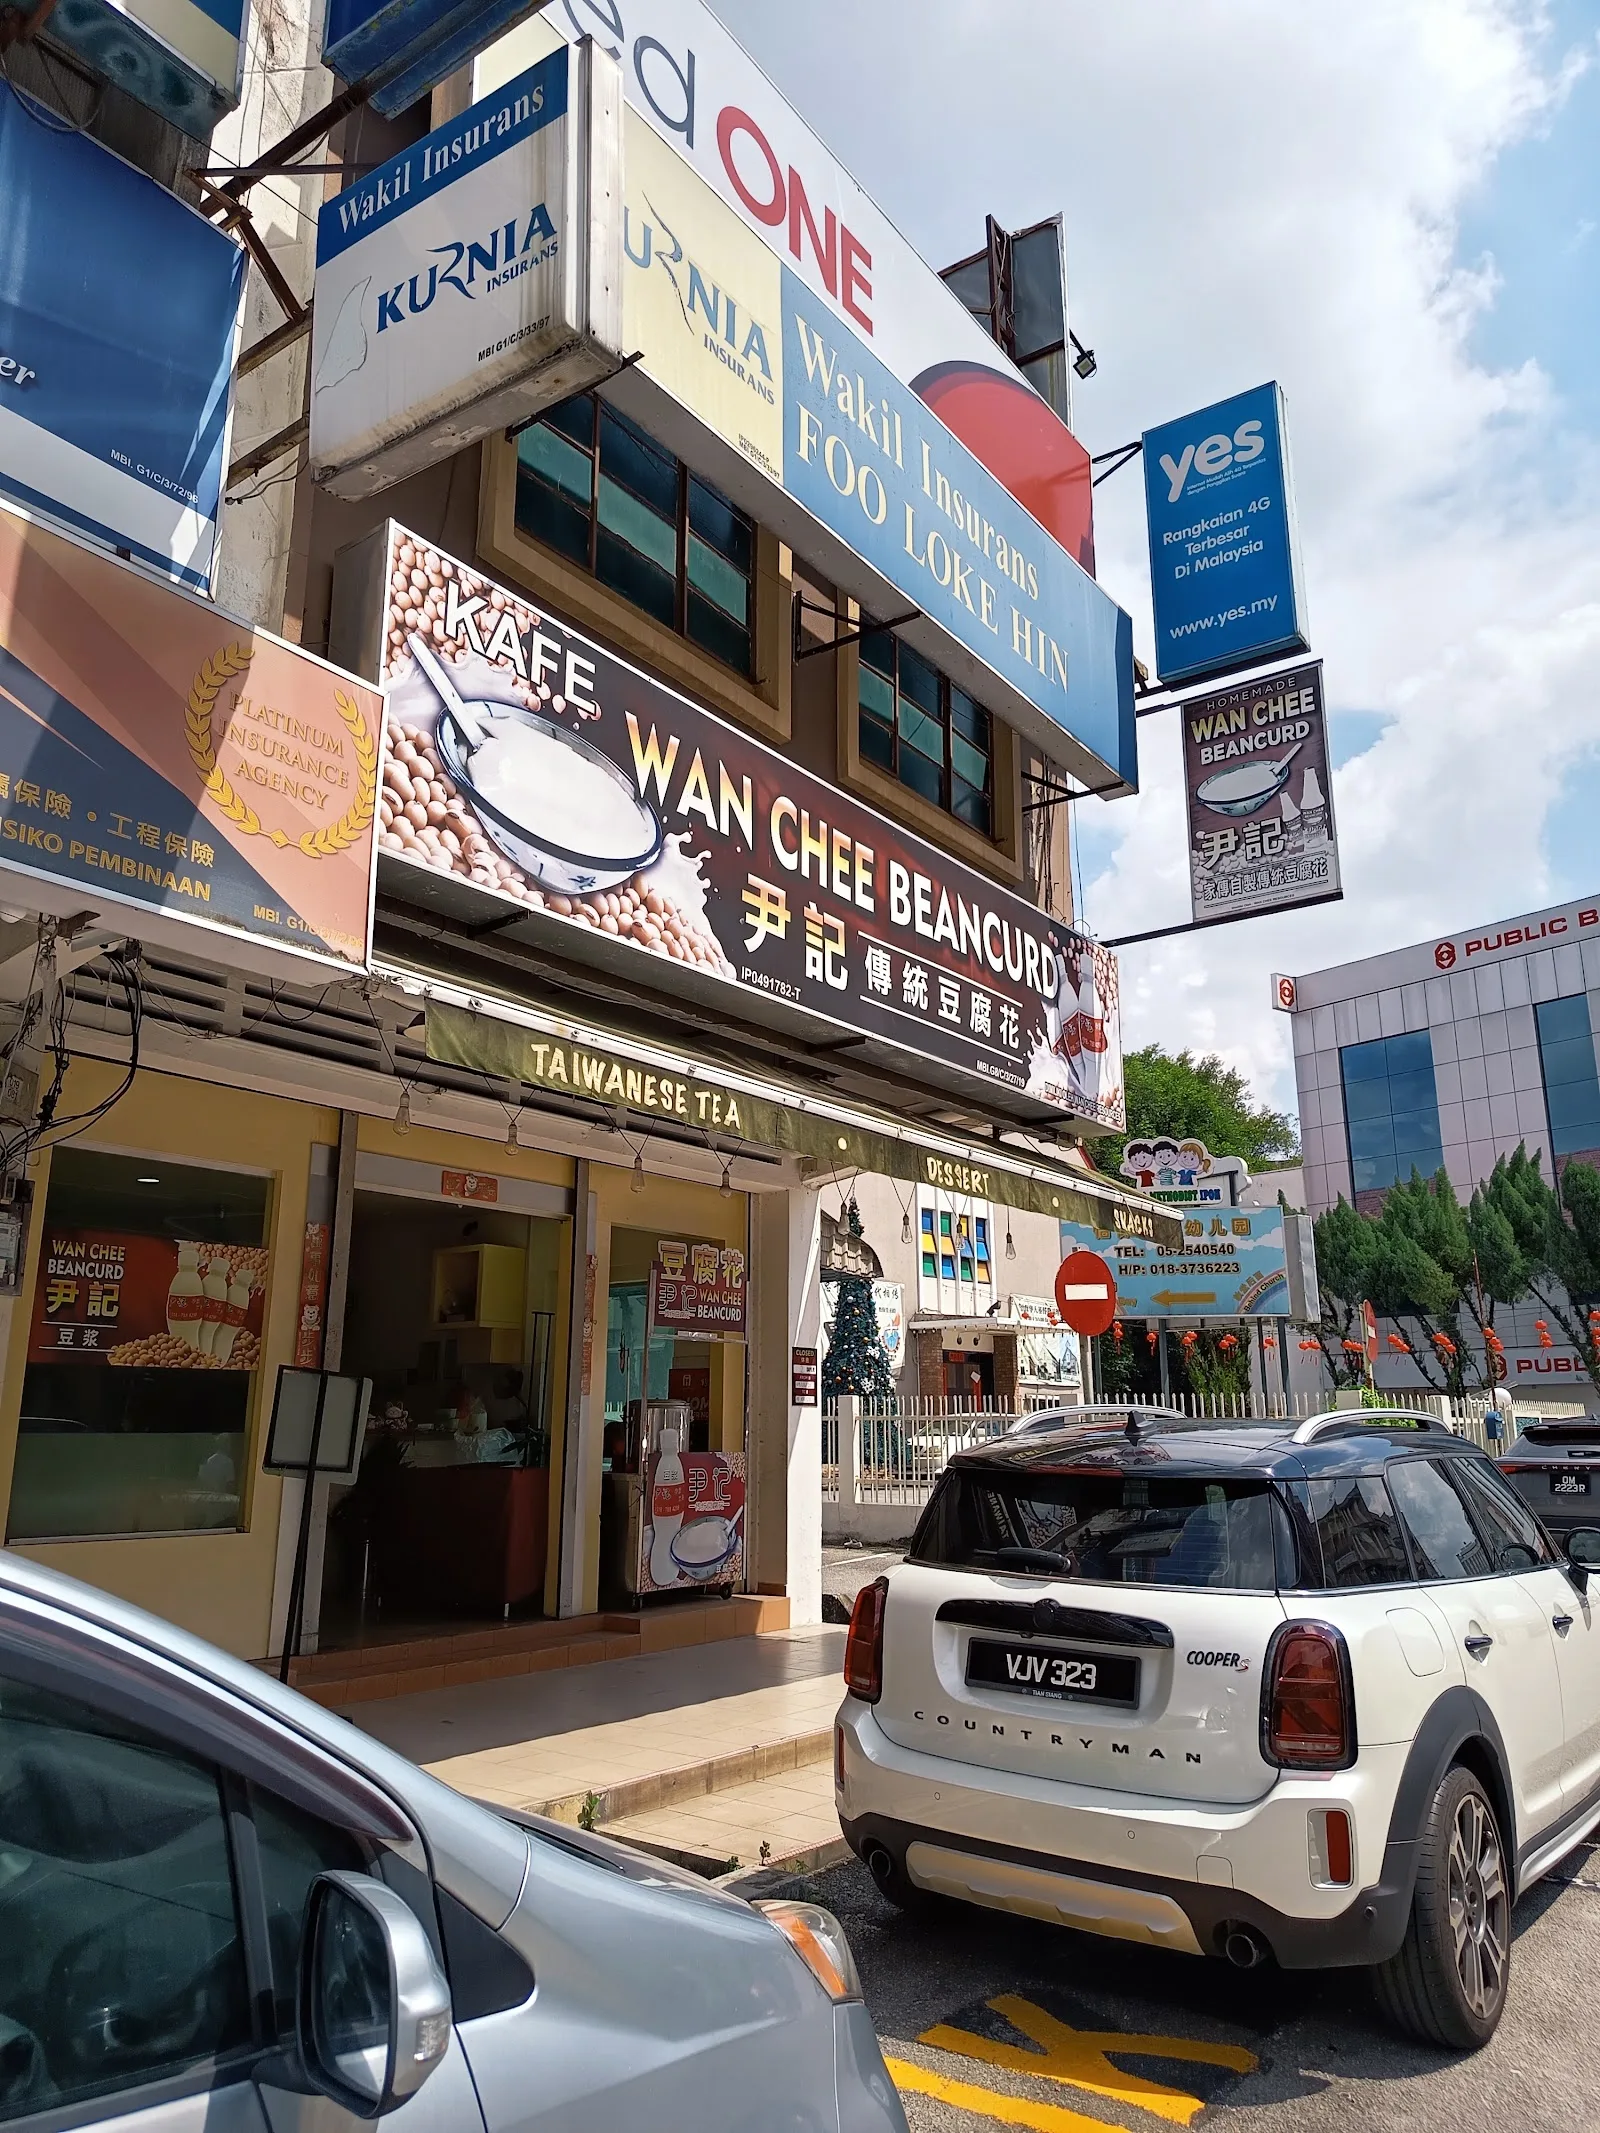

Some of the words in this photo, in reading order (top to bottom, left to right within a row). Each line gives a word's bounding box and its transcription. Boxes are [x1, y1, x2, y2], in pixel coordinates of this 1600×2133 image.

[339, 160, 411, 234] Wakil
[421, 84, 544, 184] Insurans
[716, 105, 874, 337] ONE
[376, 202, 557, 334] KURNIA
[486, 241, 559, 293] INSURANS
[625, 190, 775, 384] URNIA
[478, 344, 495, 362] MBI
[703, 333, 775, 407] INSURANS
[110, 449, 134, 469] MBI.
[794, 313, 904, 471] Wakil
[919, 436, 1039, 601] Insurans
[1159, 420, 1264, 503] yes
[1163, 508, 1244, 546] Rangkaian
[1247, 496, 1271, 514] 4G
[1184, 524, 1250, 556] Terbesar
[796, 401, 888, 525] FOO
[903, 500, 999, 636] LOKE
[1010, 604, 1070, 694] HIN
[1174, 562, 1190, 580] Di
[1194, 539, 1264, 573] Malaysia
[1169, 594, 1278, 640] www.yes.my
[443, 580, 598, 717] KAFE
[1190, 706, 1247, 744] WAN
[1252, 686, 1316, 726] CHEE
[1206, 676, 1297, 712] HOMEMADE
[229, 690, 344, 758] PLATINUM
[1200, 720, 1310, 766] BEANCURD
[218, 716, 349, 788] INSURANCE
[233, 758, 330, 810] AGENCY
[624, 710, 753, 851] WAN
[769, 795, 876, 914] CHEE
[888, 859, 1060, 1000] BEANCURD
[1201, 815, 1286, 871] 尹記
[69, 840, 211, 902] PEMBINAAN
[253, 903, 284, 926] MBI.
[741, 872, 849, 992] 尹記
[1464, 917, 1569, 958] PUBLIC
[741, 966, 801, 1002] IP0491782-T
[864, 943, 1021, 1051] 傳統豆腐花
[530, 1043, 688, 1116] TAIWANESE
[694, 1090, 742, 1129] TEA
[926, 1156, 991, 1196] DESSERT
[1113, 1208, 1154, 1238] SNACKS
[47, 1258, 125, 1281] BEANCURD
[52, 1240, 86, 1259] WAN
[89, 1243, 126, 1262] CHEE
[658, 1240, 745, 1289] 豆腐花
[1115, 1246, 1145, 1258] TEL:
[1157, 1244, 1235, 1257] 05-2540540
[1118, 1264, 1147, 1276] H/P:
[1150, 1262, 1240, 1275] 018-3736223
[46, 1278, 120, 1318] 尹記
[697, 1304, 742, 1322] BEANCURD
[699, 1288, 720, 1304] WAN
[721, 1291, 742, 1306] CHEE
[1244, 1288, 1263, 1311] Behind
[1260, 1273, 1285, 1291] Church
[795, 1349, 815, 1357] CLOSED
[1516, 1357, 1590, 1373] PUBL
[1554, 1483, 1586, 1493] 2223R
[1006, 1653, 1049, 1683] VJV
[1050, 1659, 1096, 1690] 323
[1186, 1650, 1241, 1668] COOPER
[1032, 1689, 1045, 1697] TIAN
[914, 1710, 1201, 1764] COUNTRYMAN
